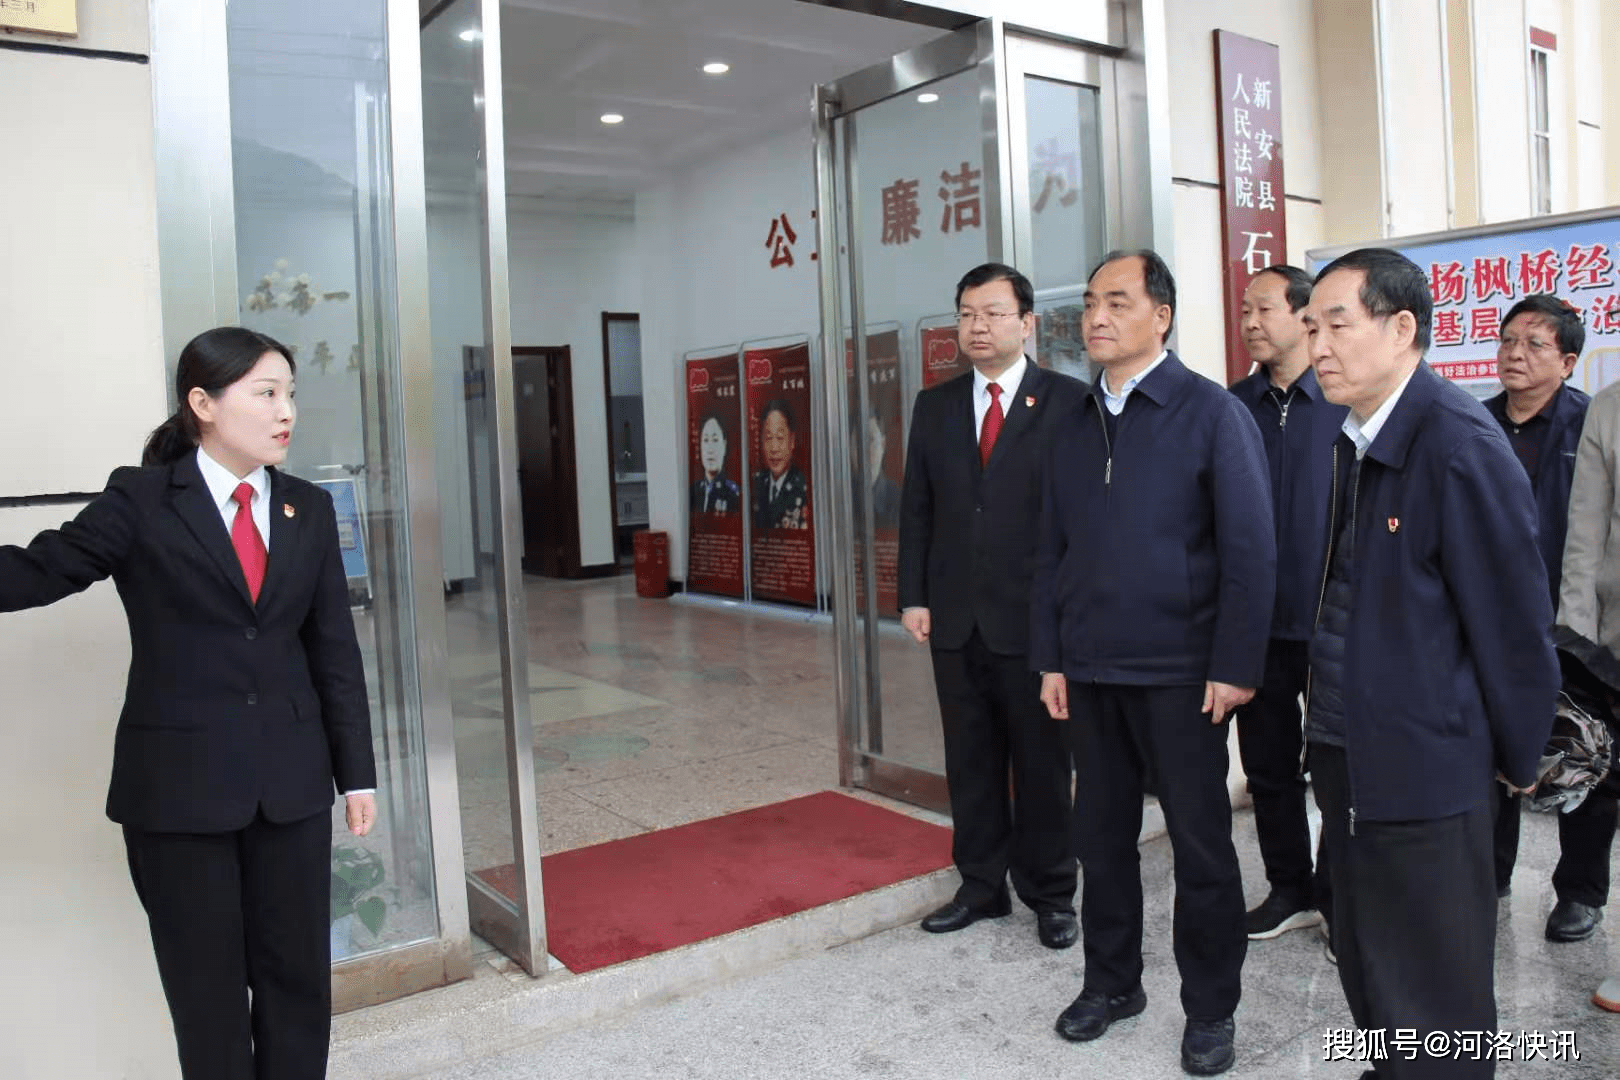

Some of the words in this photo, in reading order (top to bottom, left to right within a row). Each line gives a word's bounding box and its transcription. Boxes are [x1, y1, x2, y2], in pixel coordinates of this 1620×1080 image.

[1231, 73, 1254, 208] 人民法院
[1253, 77, 1276, 211] 新安县
[881, 161, 982, 245] 廉洁
[1240, 231, 1273, 275] 石
[1428, 245, 1620, 306] 扬枫桥经
